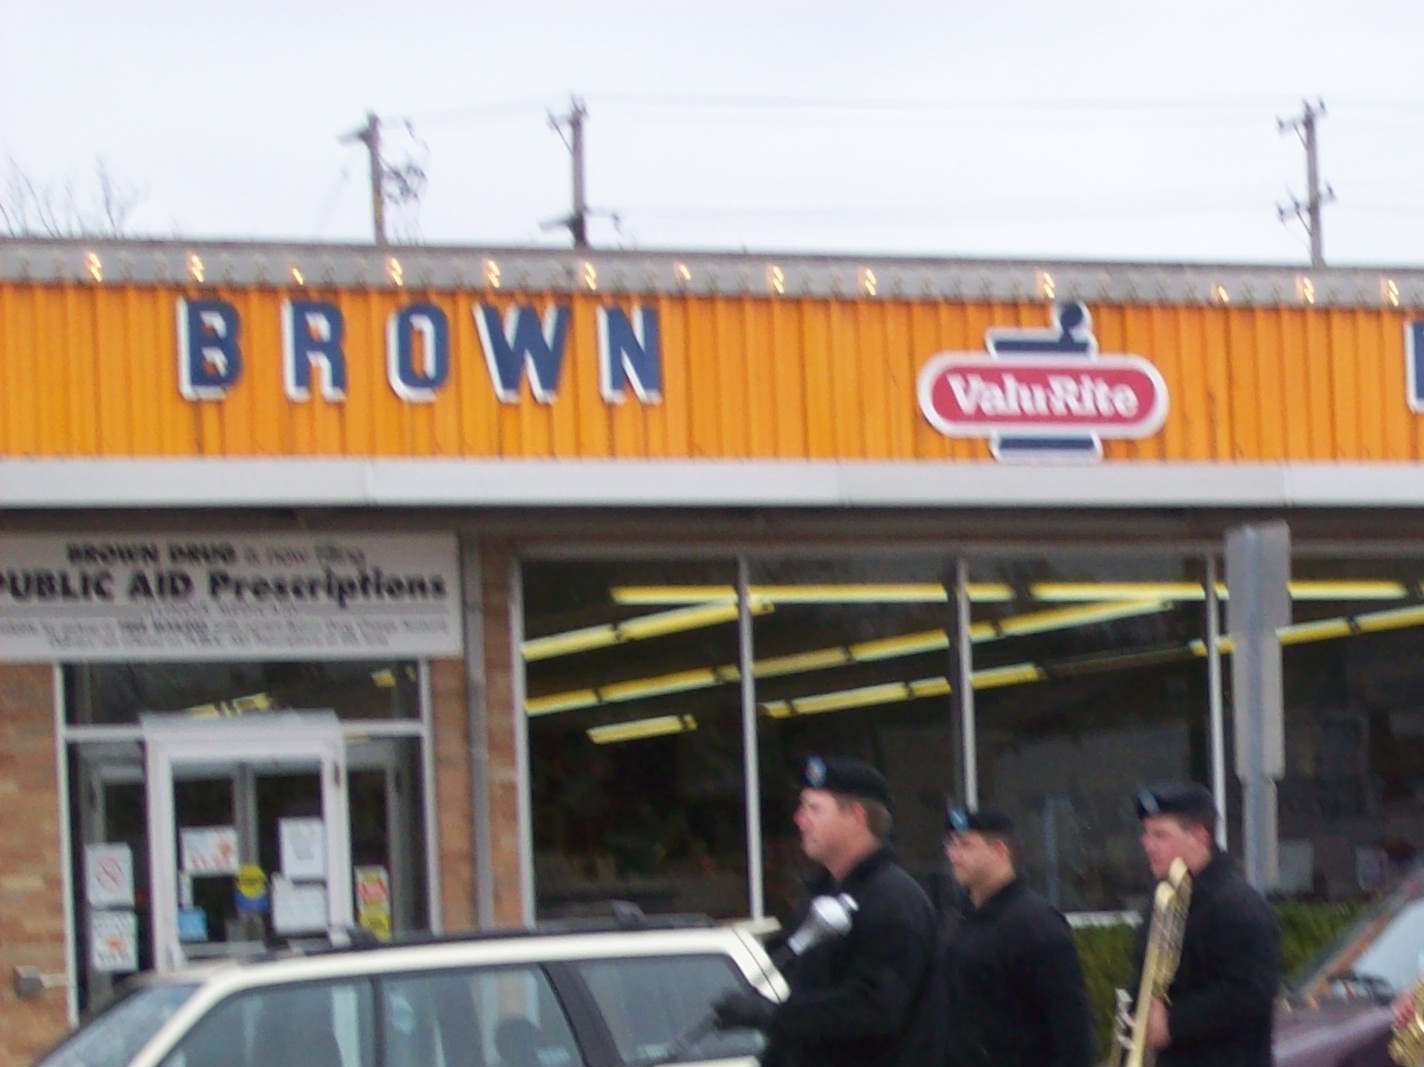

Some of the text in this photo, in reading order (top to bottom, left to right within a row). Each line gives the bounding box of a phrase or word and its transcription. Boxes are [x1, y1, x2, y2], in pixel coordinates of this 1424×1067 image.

[177, 296, 663, 404] BROWN
[946, 372, 1139, 418] ValuRite
[127, 571, 194, 601] AID
[207, 567, 447, 607] Prescriptions
